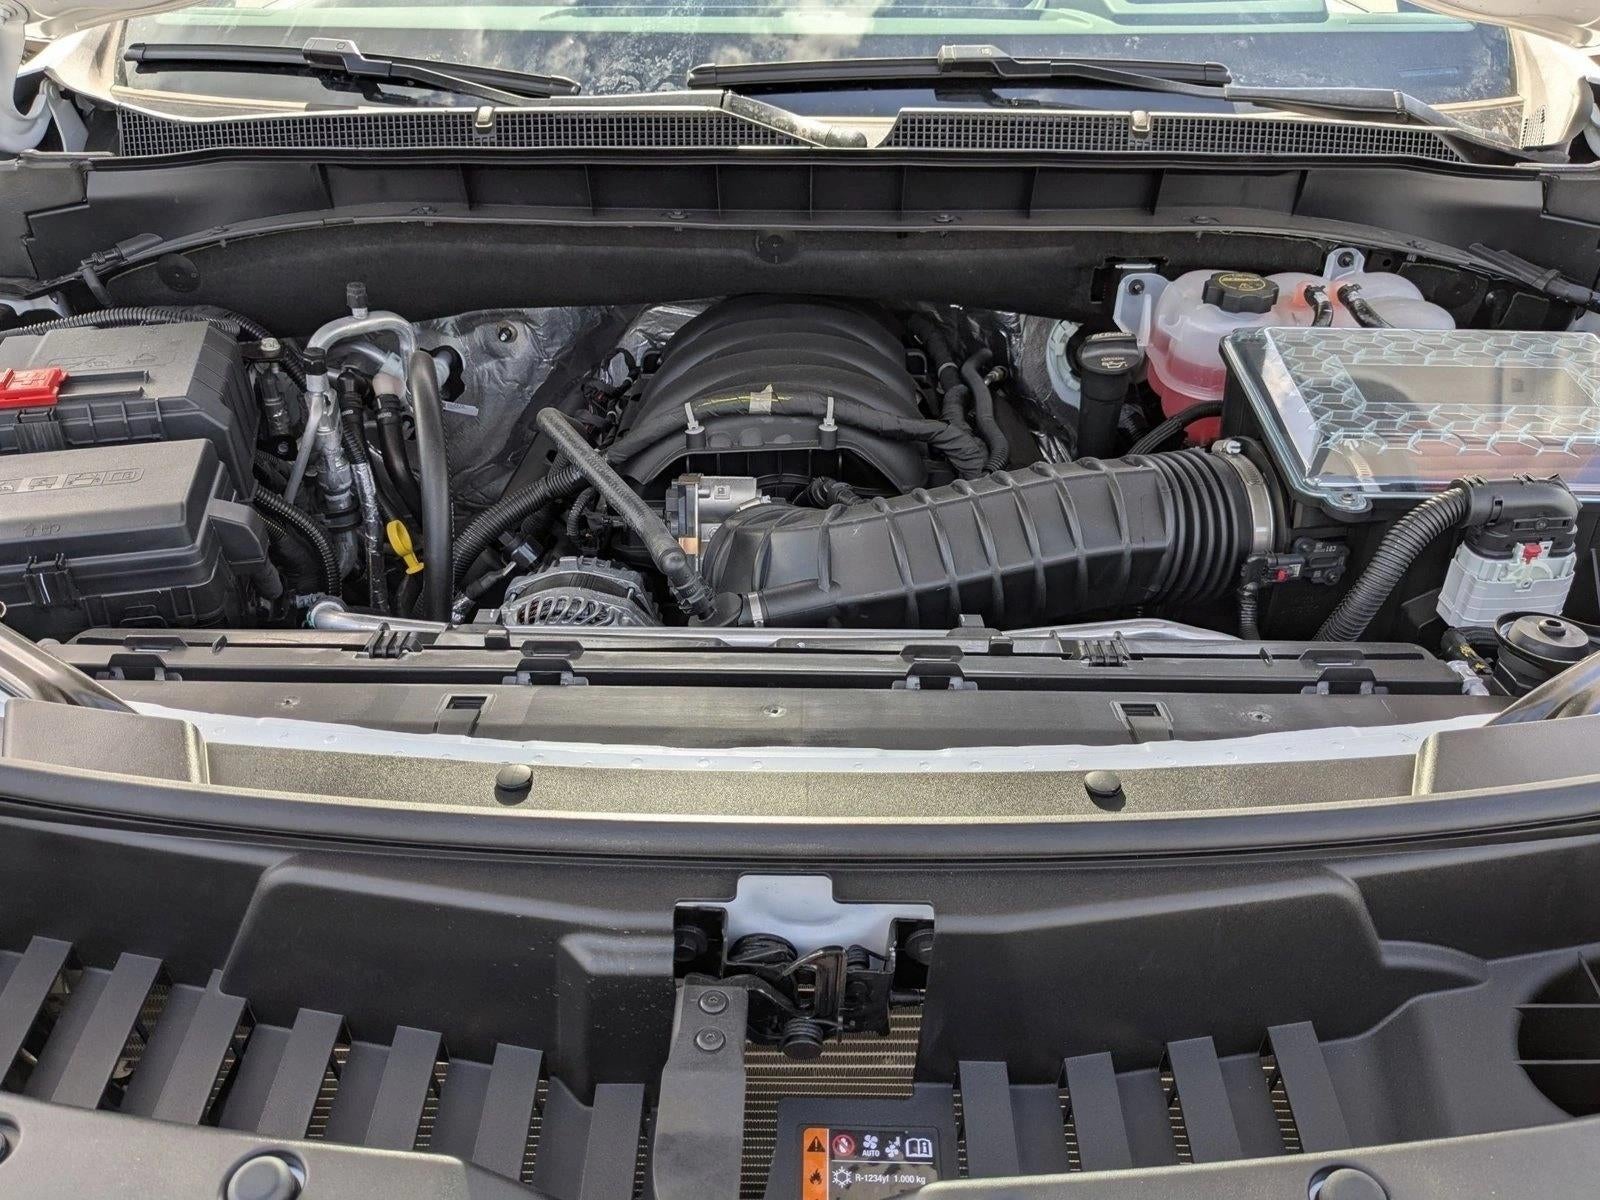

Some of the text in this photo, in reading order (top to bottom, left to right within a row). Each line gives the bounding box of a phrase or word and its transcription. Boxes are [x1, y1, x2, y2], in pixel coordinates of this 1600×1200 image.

[855, 1174, 926, 1185] R-1234yf 1.000 kg
